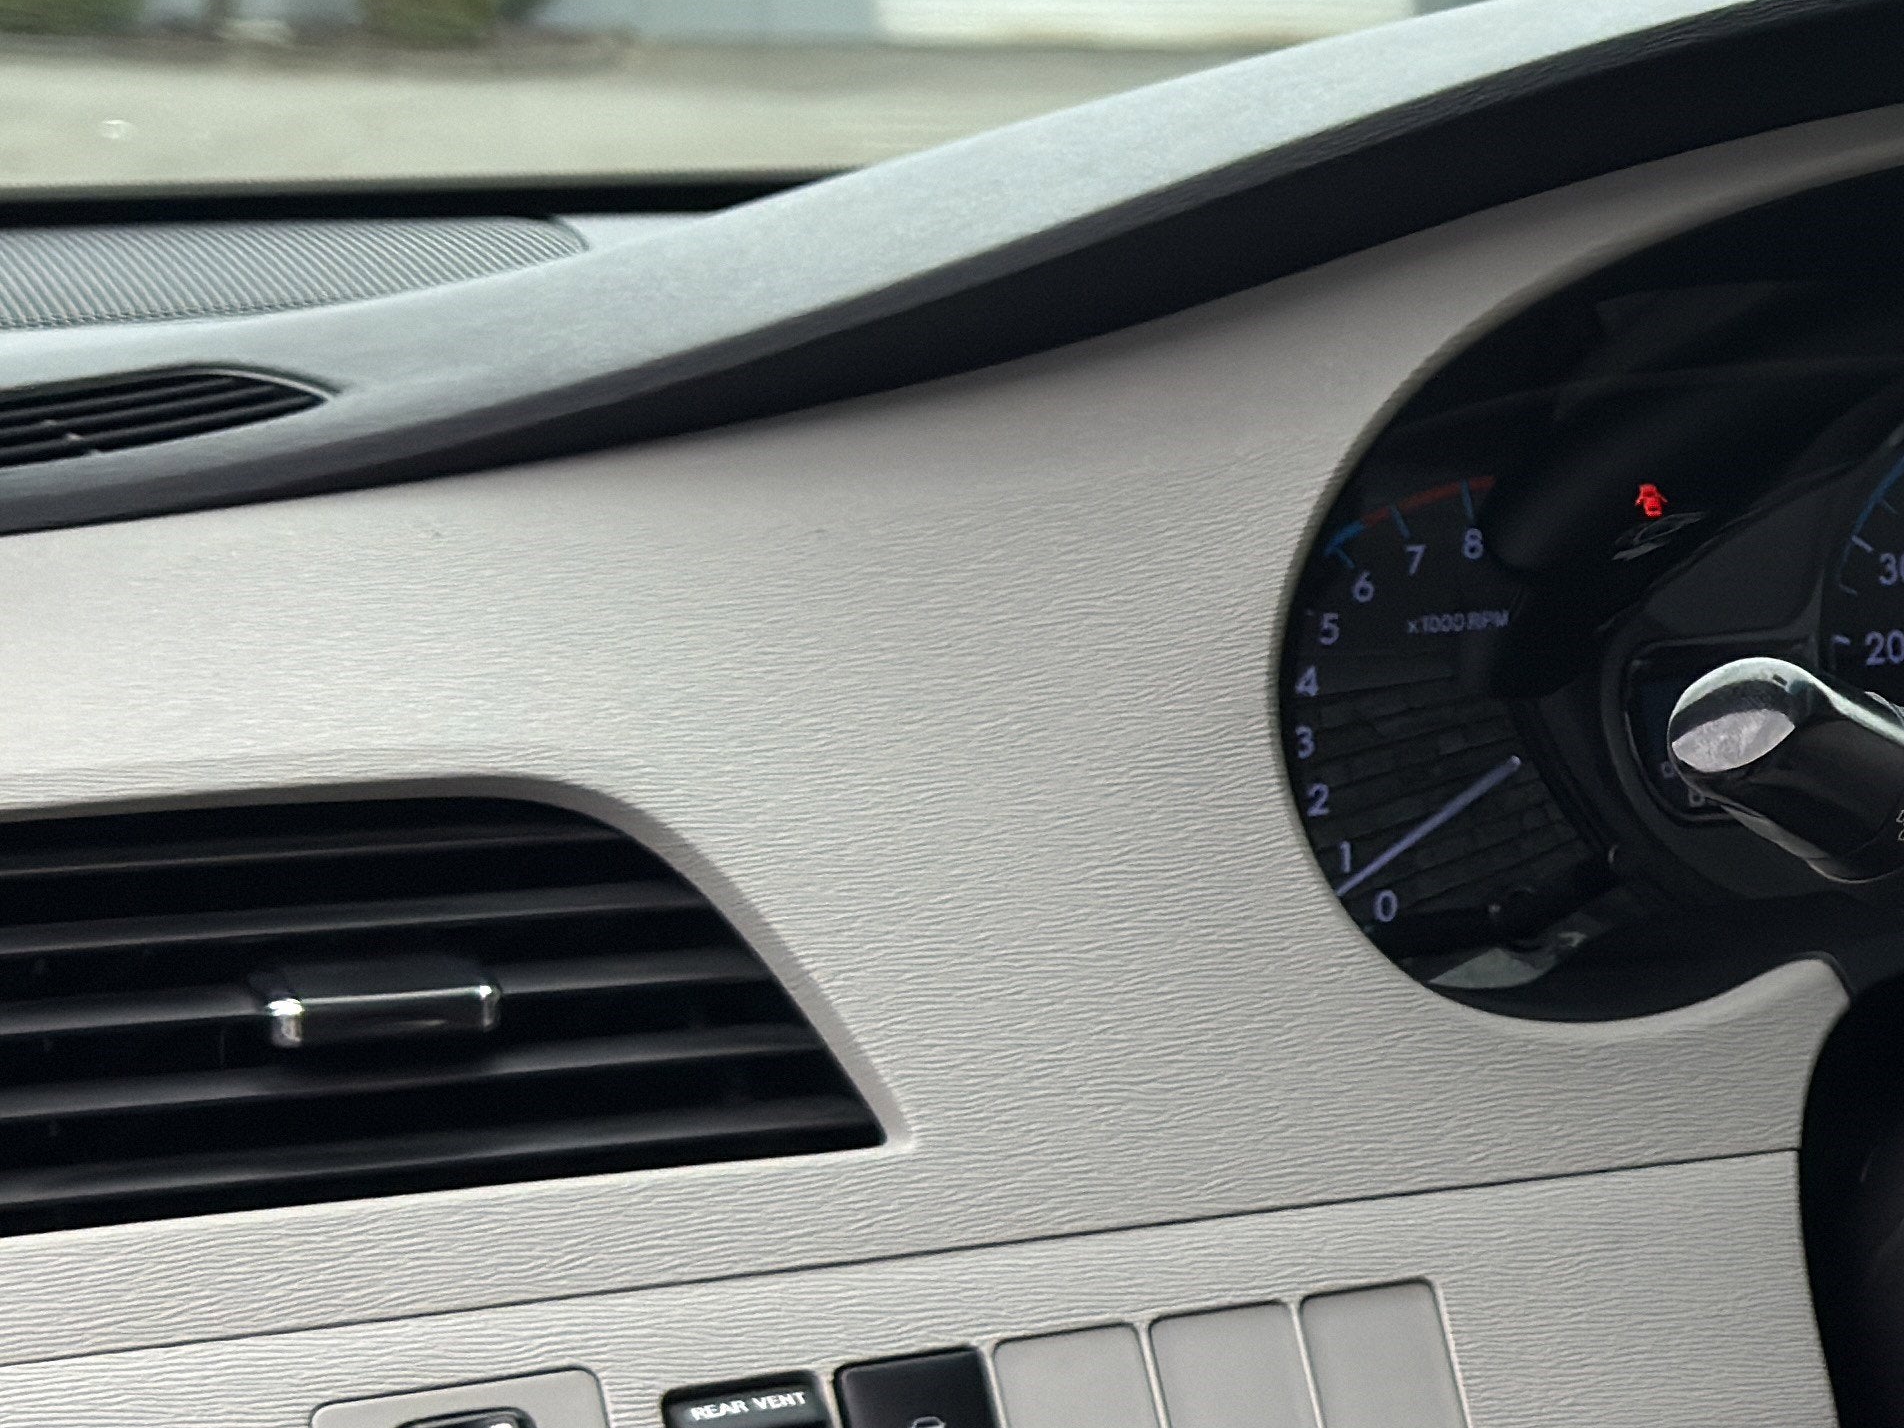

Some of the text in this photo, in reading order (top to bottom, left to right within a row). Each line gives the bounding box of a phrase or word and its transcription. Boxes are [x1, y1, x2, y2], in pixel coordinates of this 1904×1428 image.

[1462, 529, 1485, 559] 8
[1405, 545, 1426, 575] 7
[1352, 572, 1376, 602] 6
[1319, 612, 1341, 645] 5
[1296, 667, 1318, 698] 4
[1297, 726, 1315, 758] 3
[1307, 785, 1330, 817] 2
[1340, 842, 1351, 873] 1
[1373, 890, 1397, 923] 0
[690, 1391, 806, 1421] REAR VENT
